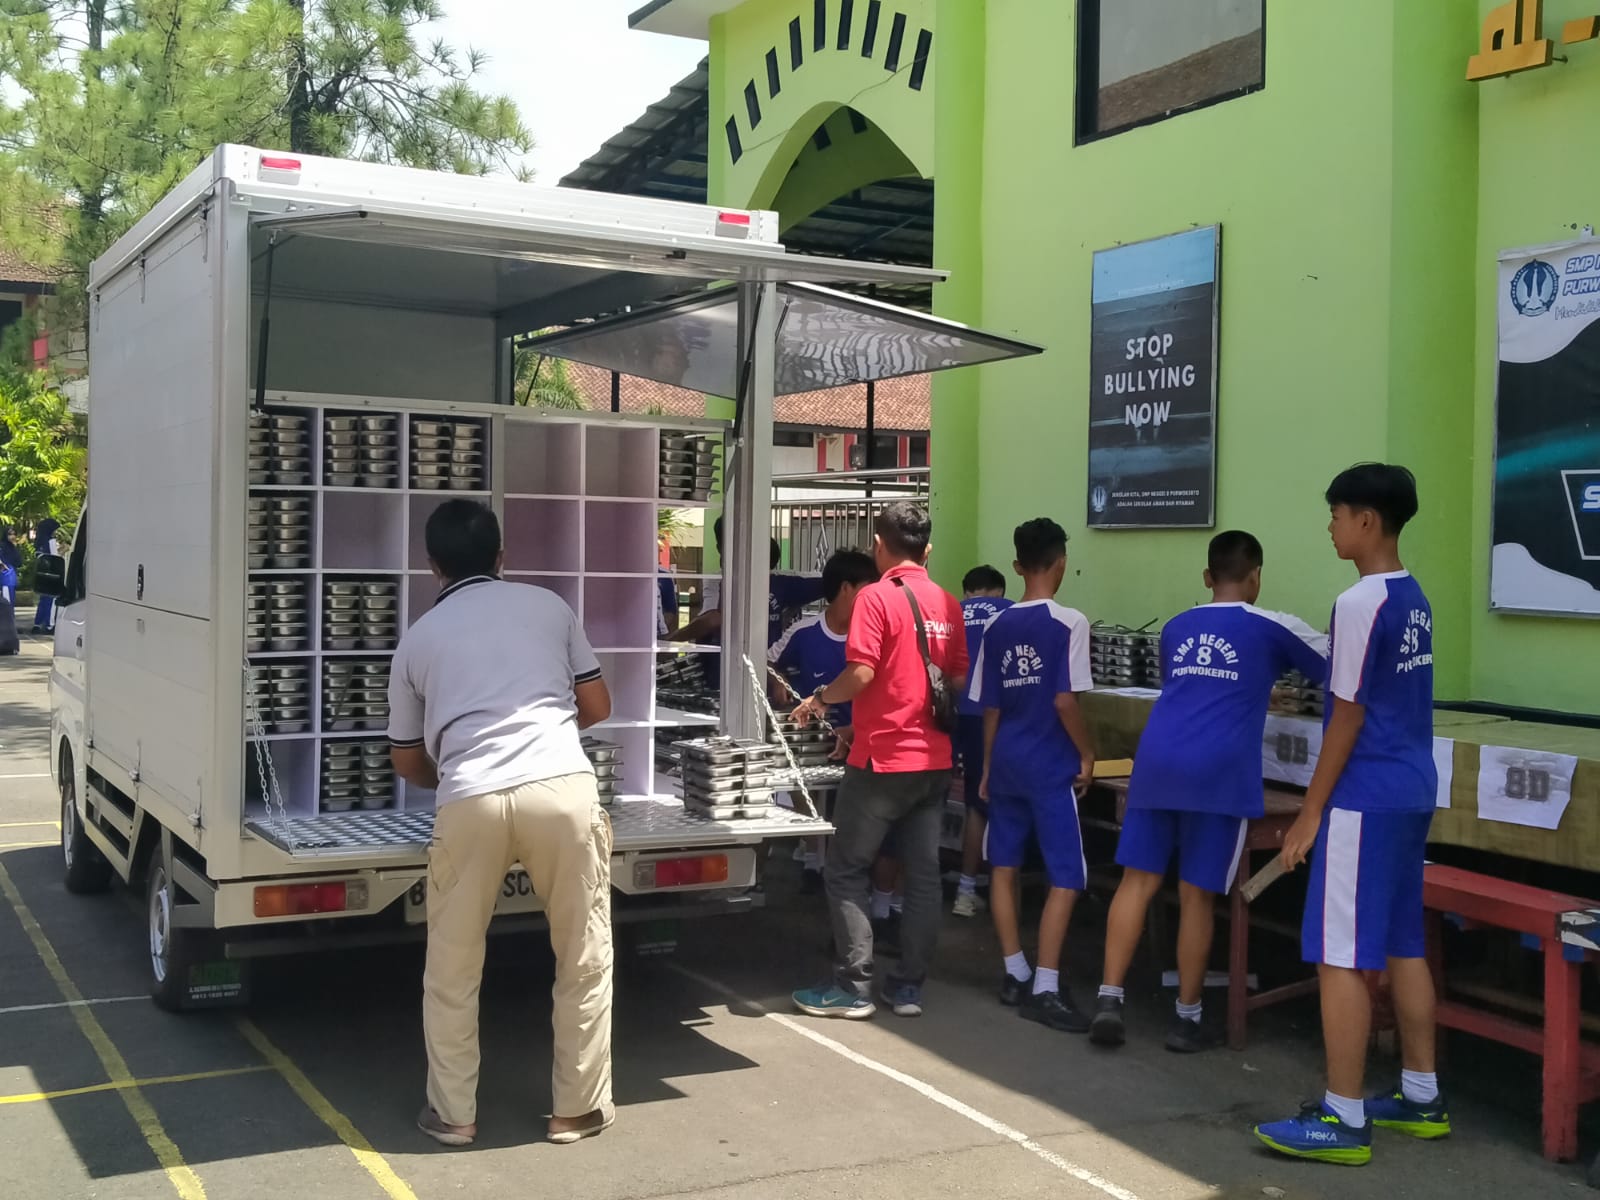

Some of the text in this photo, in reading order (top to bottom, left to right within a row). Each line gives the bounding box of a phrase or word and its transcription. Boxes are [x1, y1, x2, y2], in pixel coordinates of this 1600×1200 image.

[1565, 255, 1595, 274] SMP
[1126, 333, 1173, 360] STOP
[1104, 364, 1195, 395] BULLYING
[1125, 400, 1171, 428] NOW
[963, 609, 974, 620] 8
[1173, 633, 1239, 664] SMP NEGERI
[1411, 627, 1419, 653] 8
[1017, 657, 1030, 676] 8
[1196, 645, 1212, 666] 8
[409, 880, 425, 906] B
[1305, 1130, 1337, 1142] HOKA
